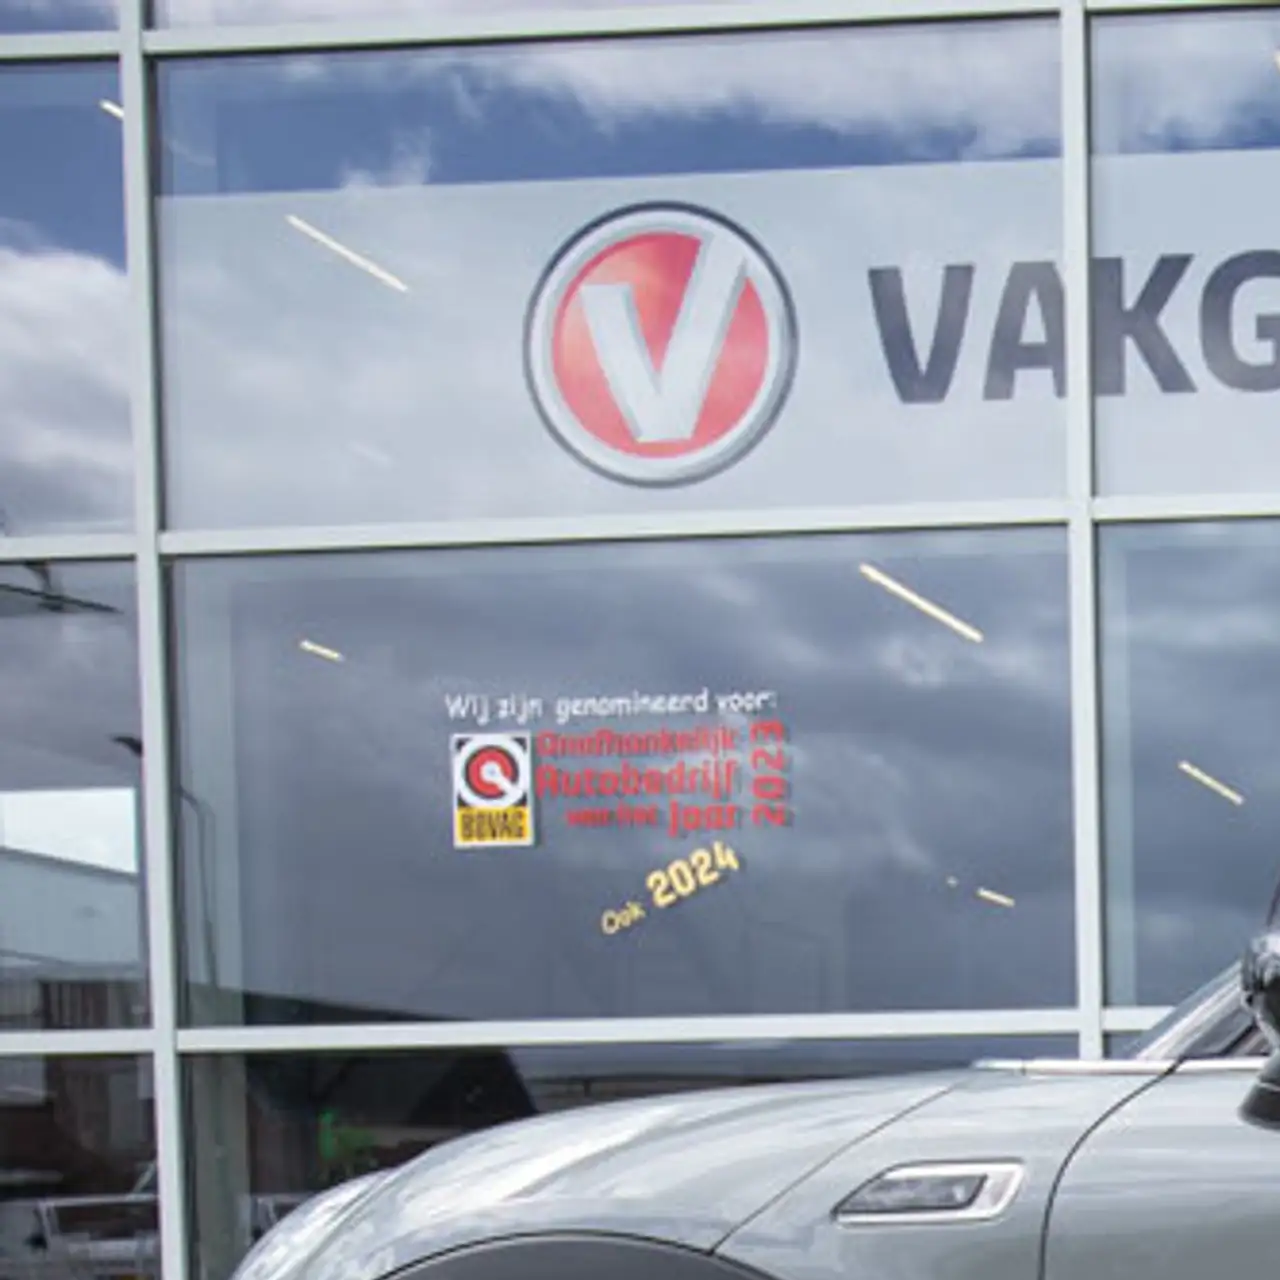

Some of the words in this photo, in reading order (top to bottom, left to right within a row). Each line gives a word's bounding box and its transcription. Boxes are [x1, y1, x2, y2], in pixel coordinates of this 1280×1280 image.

[445, 693, 490, 726] Wij
[498, 692, 543, 725] zijn
[555, 686, 708, 725] genomineerd
[535, 757, 738, 799] Autobedrijf
[751, 720, 786, 826] 2023
[602, 901, 646, 934] Ook
[646, 840, 740, 908] 2024
